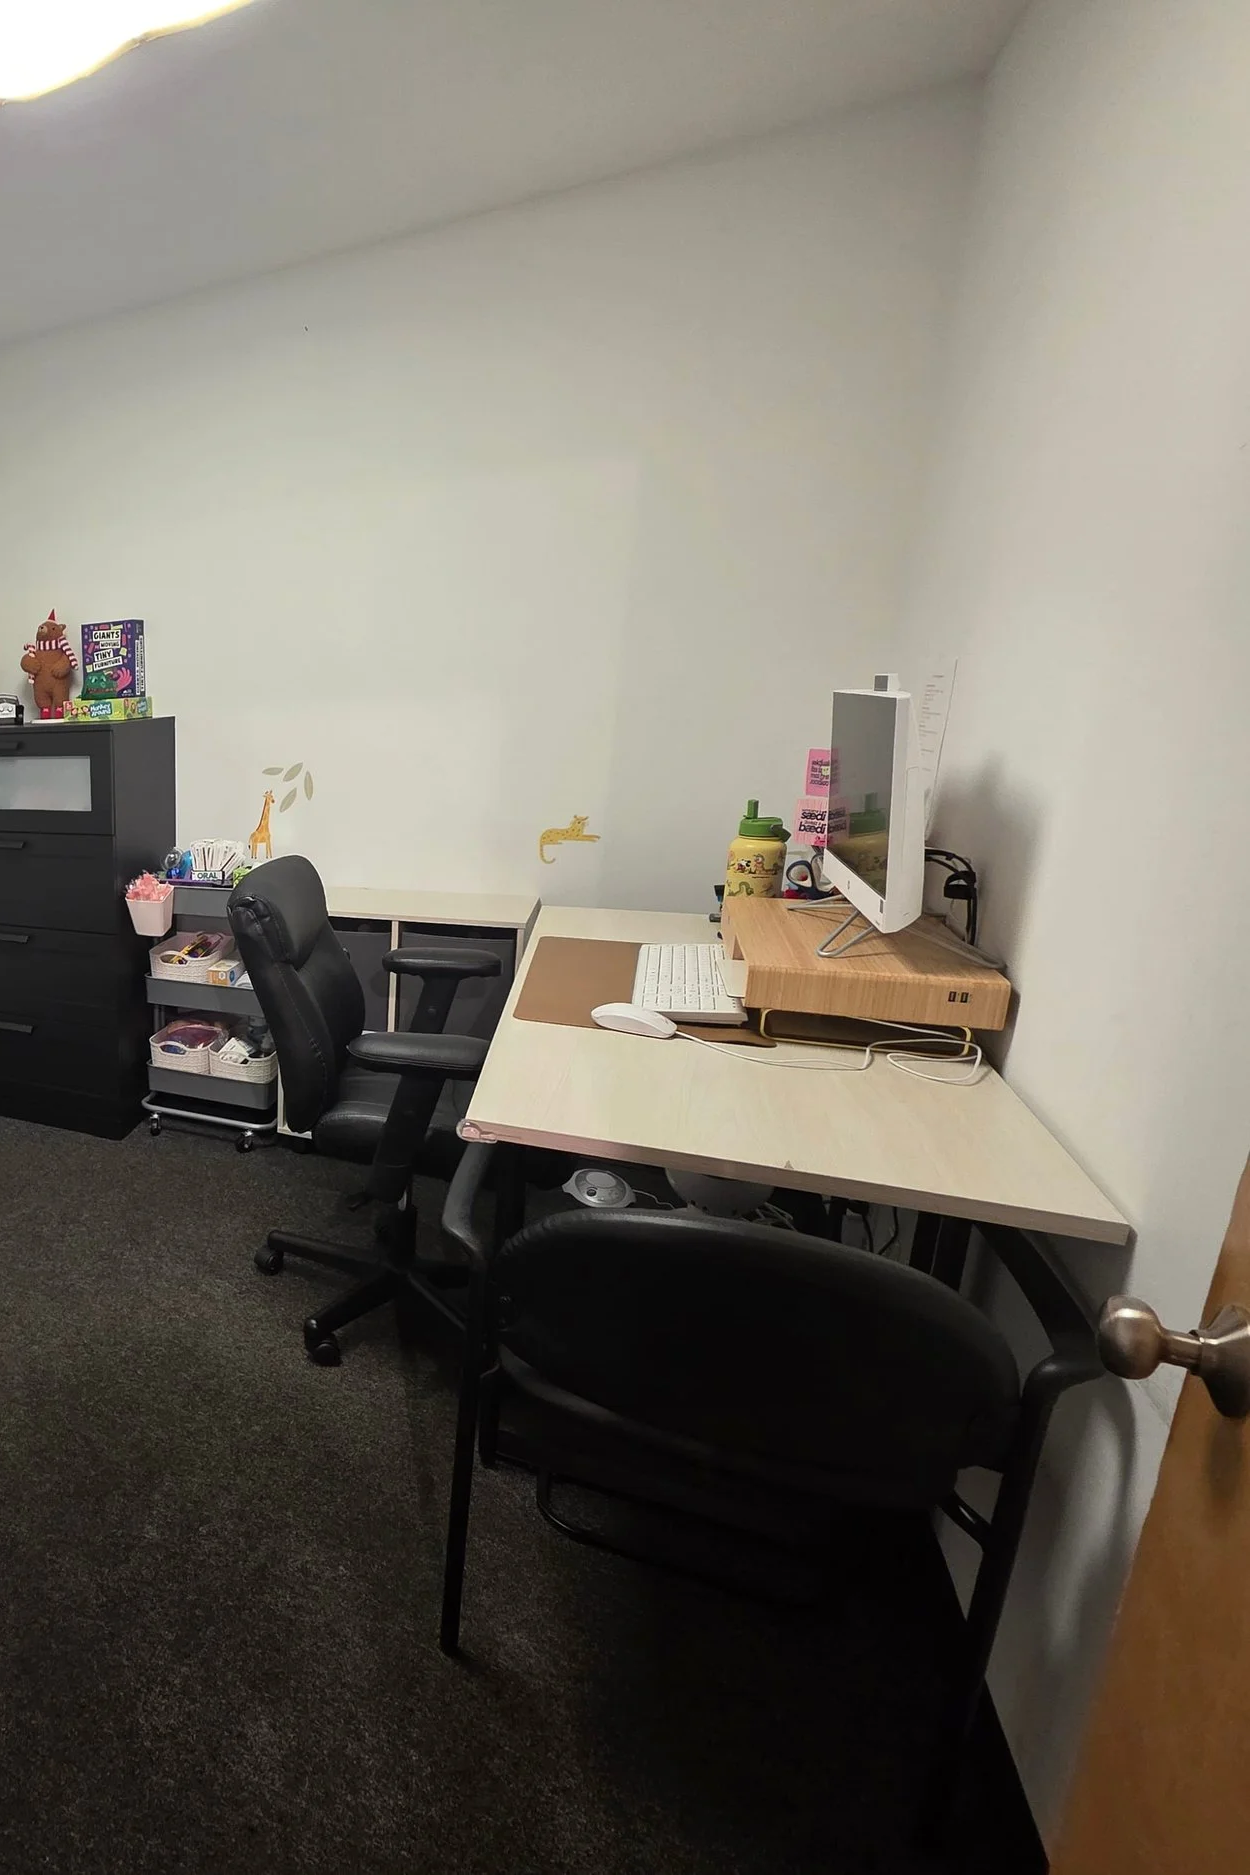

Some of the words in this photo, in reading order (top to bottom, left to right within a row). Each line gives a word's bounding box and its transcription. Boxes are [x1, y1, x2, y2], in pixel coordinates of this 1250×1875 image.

[93, 631, 120, 640] GIANTS
[95, 650, 112, 661] TINY
[94, 657, 121, 669] FURNITURE
[90, 703, 111, 712] Monkey
